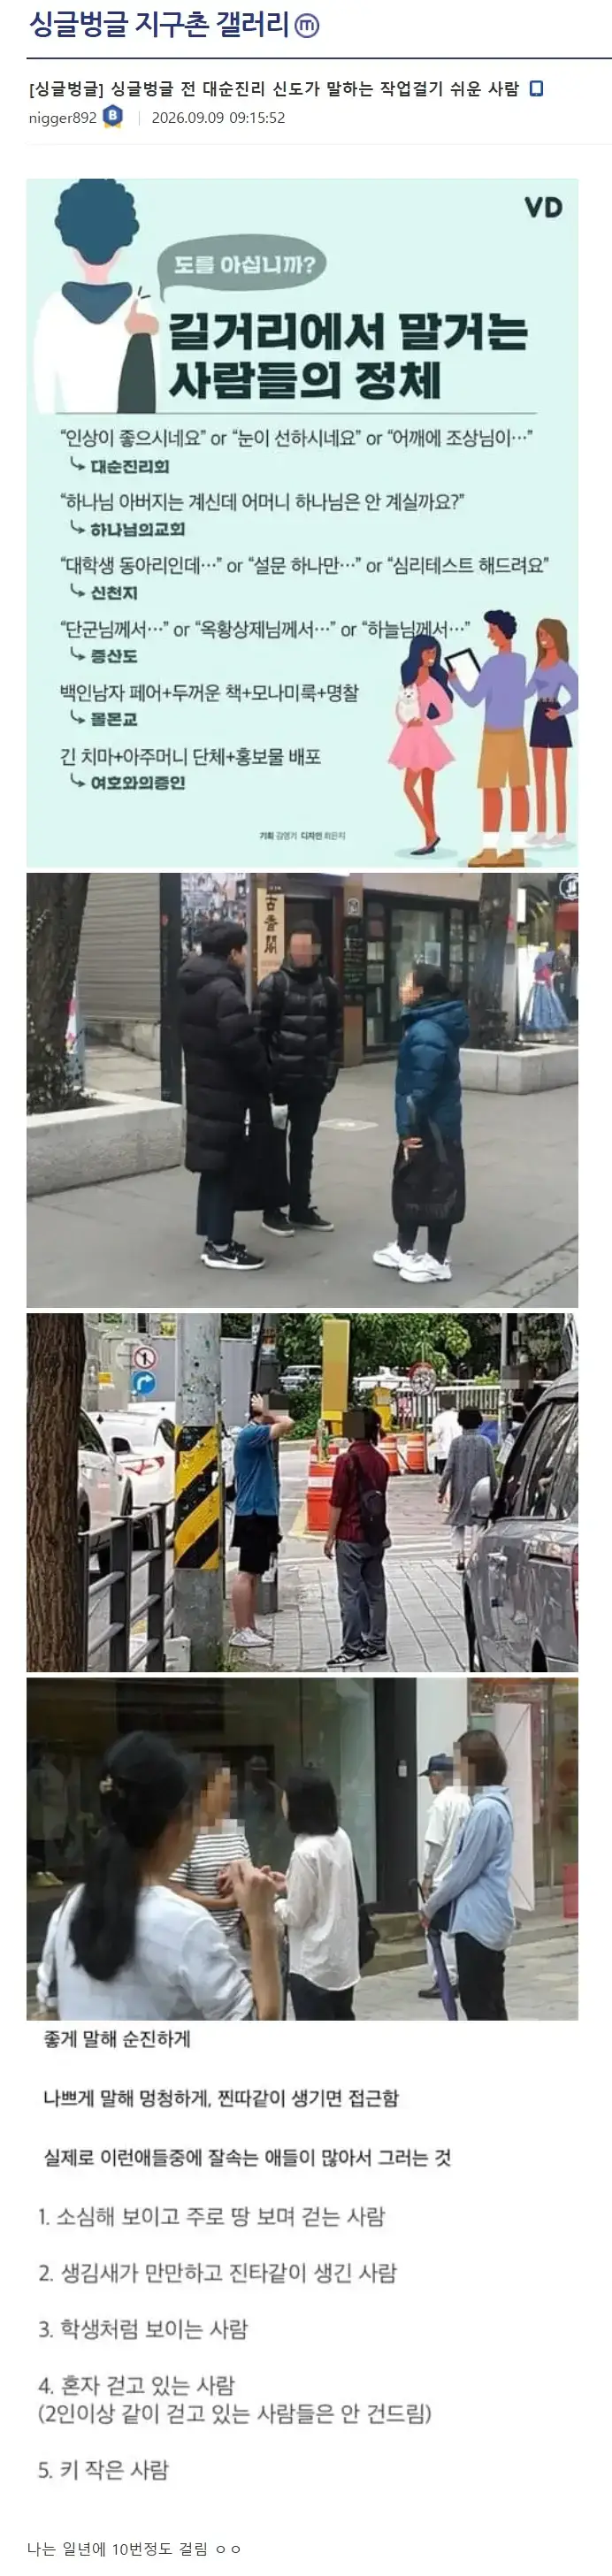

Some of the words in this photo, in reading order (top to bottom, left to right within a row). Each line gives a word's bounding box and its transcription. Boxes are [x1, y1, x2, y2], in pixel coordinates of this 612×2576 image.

[524, 195, 563, 219] VD
[174, 256, 214, 274] 도를
[220, 255, 317, 275] 아십니까?
[168, 311, 385, 352] 길거리에서
[398, 311, 529, 351] 말거는
[168, 361, 340, 400] 사람들의
[356, 361, 440, 401] 정체
[210, 433, 228, 447] or
[365, 433, 384, 447] or
[90, 459, 170, 475] 대순진리회
[119, 492, 185, 512] 아버지는
[188, 492, 237, 512] 계신데
[241, 492, 290, 512] 어머니
[295, 492, 361, 512] 하나님은
[364, 492, 382, 512] 안
[90, 521, 186, 539] 하나님의교회
[226, 561, 244, 574] or
[365, 561, 383, 574] or
[90, 585, 138, 601] 신천지
[172, 624, 191, 638] or
[340, 624, 358, 638] or
[90, 648, 139, 665] 증산도
[60, 684, 126, 703] 백인남자
[129, 683, 221, 703] 페어+두꺼운
[226, 684, 360, 703] 책+모나미룩+명찰
[90, 711, 139, 728] 몰몬교
[60, 747, 76, 767] 긴
[80, 747, 187, 767] 치마+아주머니
[193, 746, 285, 768] 단체+홍보물
[288, 747, 322, 767] 배포
[90, 776, 186, 791] 여호와의증인
